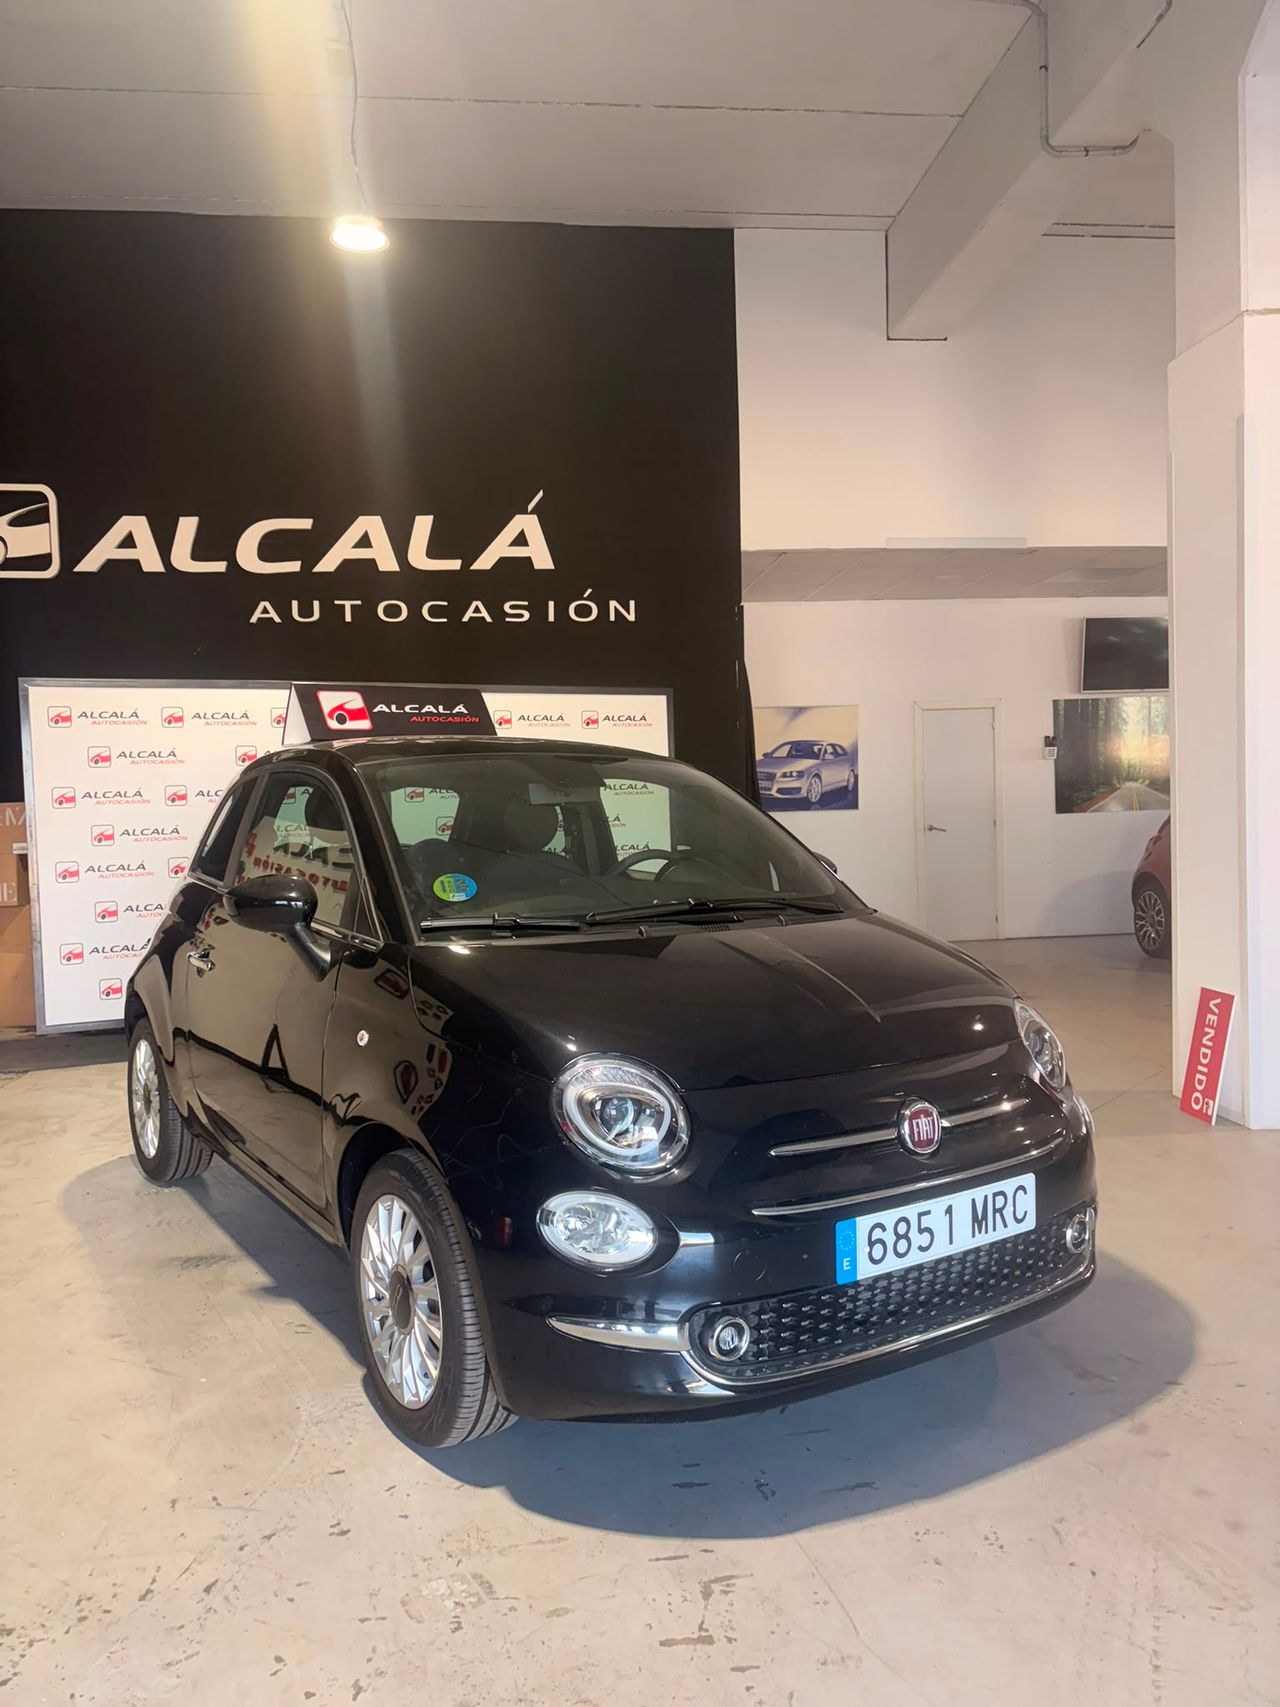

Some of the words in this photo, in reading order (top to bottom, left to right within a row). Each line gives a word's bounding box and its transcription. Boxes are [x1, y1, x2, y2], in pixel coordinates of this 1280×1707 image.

[73, 489, 555, 573] ALCALÁ
[249, 589, 637, 623] AUTOCASIÓN
[77, 708, 139, 719] ALCALÁ
[192, 709, 250, 720] ALCALÁ
[372, 704, 469, 714] ALCALÁ
[517, 713, 565, 722] ALCALÁ
[602, 713, 647, 722] ALCALÁ
[116, 747, 177, 759] ALCALÁ
[81, 788, 143, 799] ALCALÁ
[195, 789, 224, 798] ALC
[120, 825, 180, 837] ALCALÁ
[615, 841, 651, 852] LCALÁ
[84, 860, 146, 873] ALCALÁ
[123, 903, 166, 912] ALCA
[1191, 998, 1222, 1111] VENDIDO
[912, 1114, 934, 1142] FIAT
[866, 1204, 954, 1266] 6851
[971, 1184, 1028, 1239] MRC
[843, 1258, 851, 1271] E
